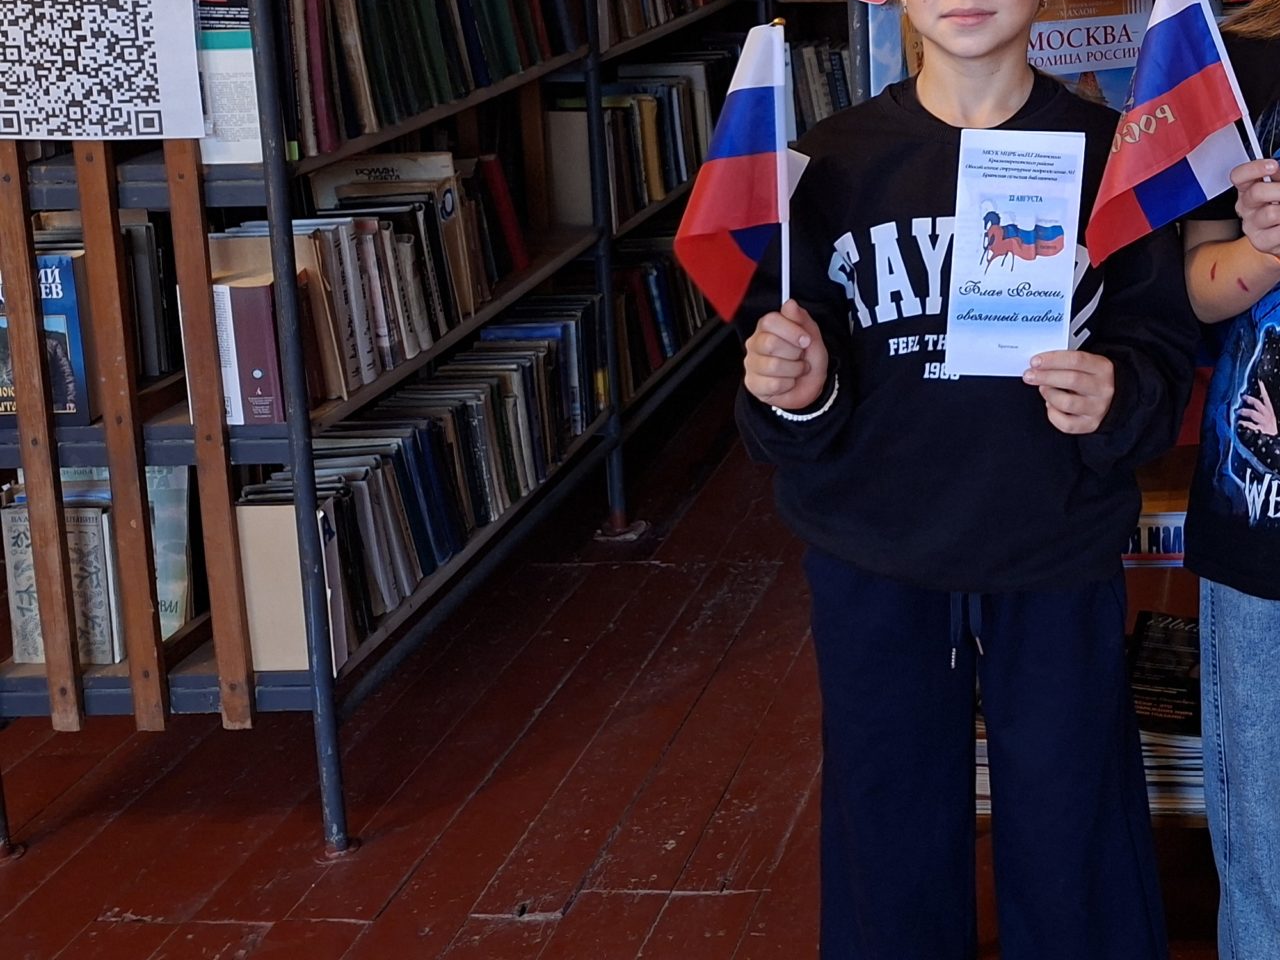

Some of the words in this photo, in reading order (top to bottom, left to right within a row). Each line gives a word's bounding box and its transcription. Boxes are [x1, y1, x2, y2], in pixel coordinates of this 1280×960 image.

[1028, 53, 1082, 67] ТОЛИЦА
[1087, 46, 1140, 63] РОССИИ
[1016, 195, 1043, 203] АВГУСТА
